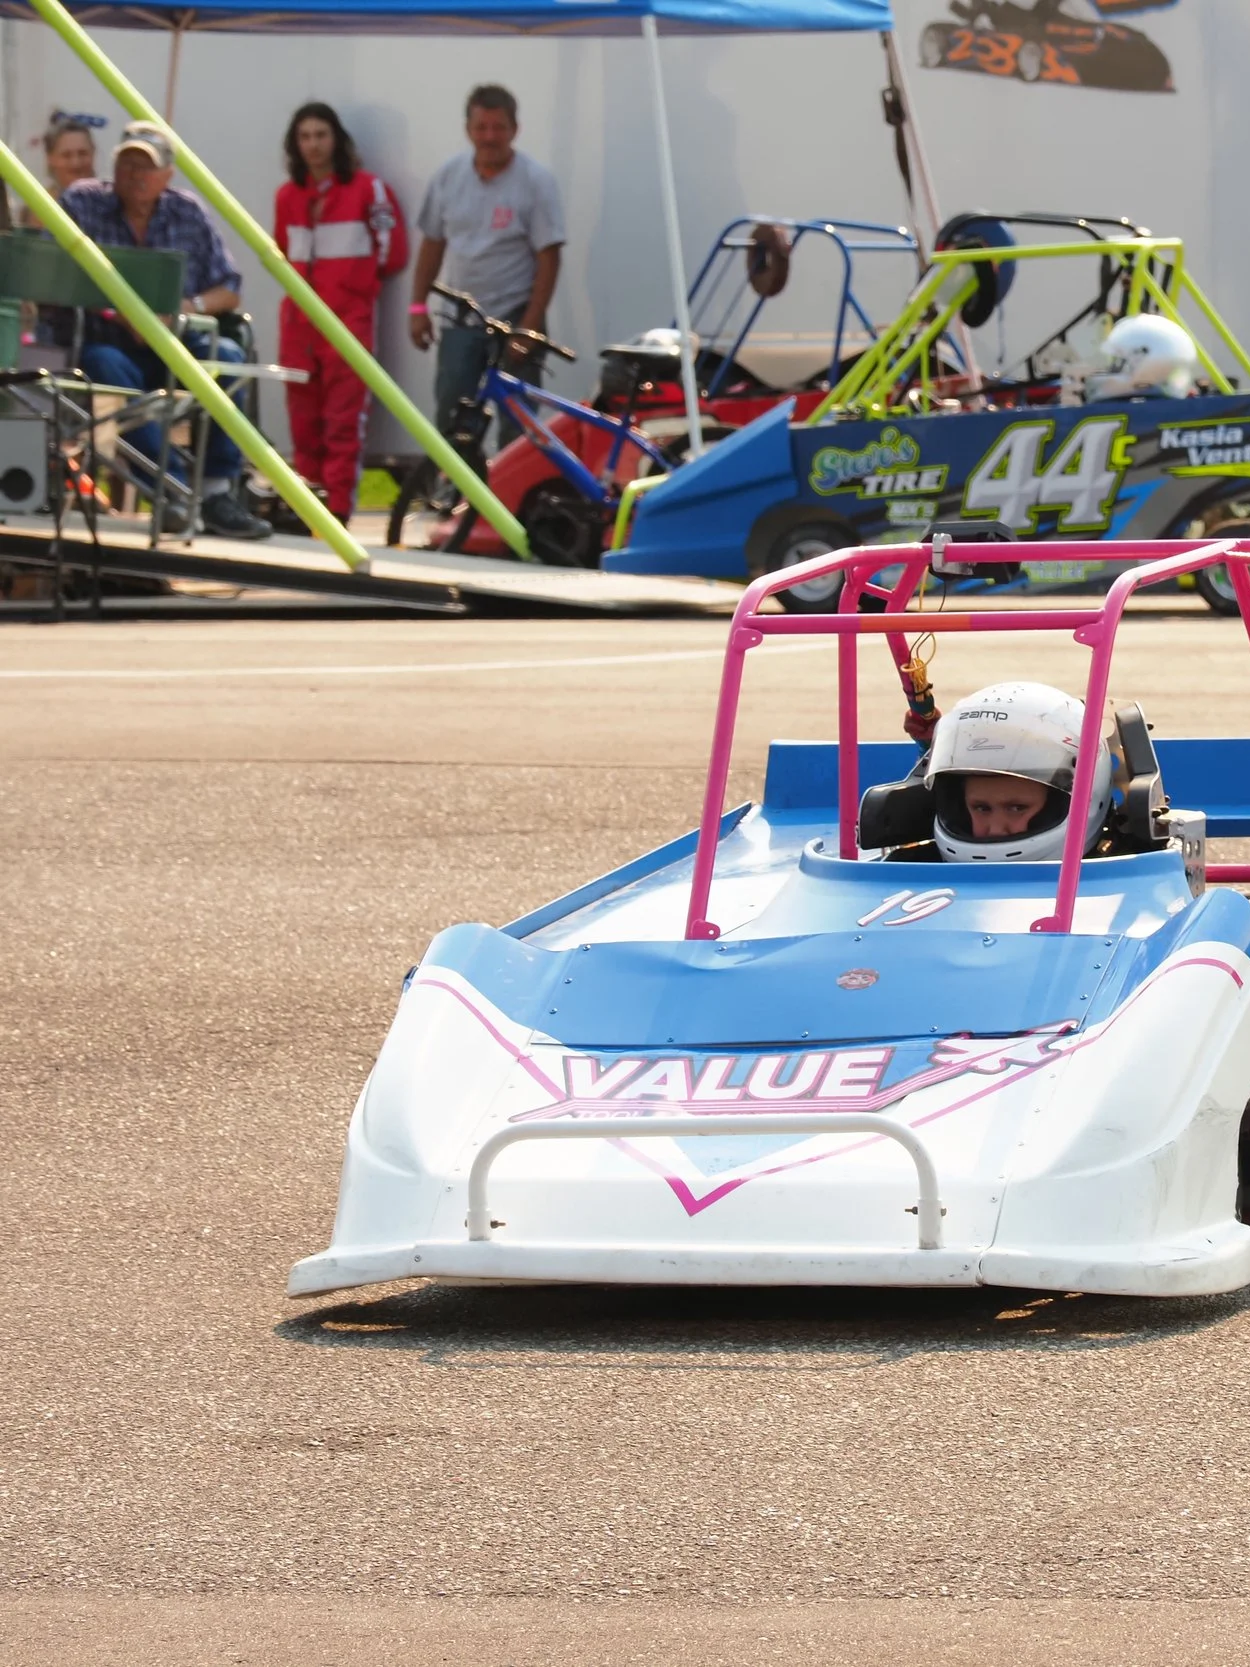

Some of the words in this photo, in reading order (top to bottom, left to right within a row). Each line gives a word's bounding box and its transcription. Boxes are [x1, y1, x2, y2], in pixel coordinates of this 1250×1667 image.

[1160, 425, 1243, 449] Kasia
[863, 469, 942, 496] TIRE
[958, 710, 1009, 722] zamp
[856, 888, 956, 926] 19
[563, 1047, 893, 1101] VALUE
